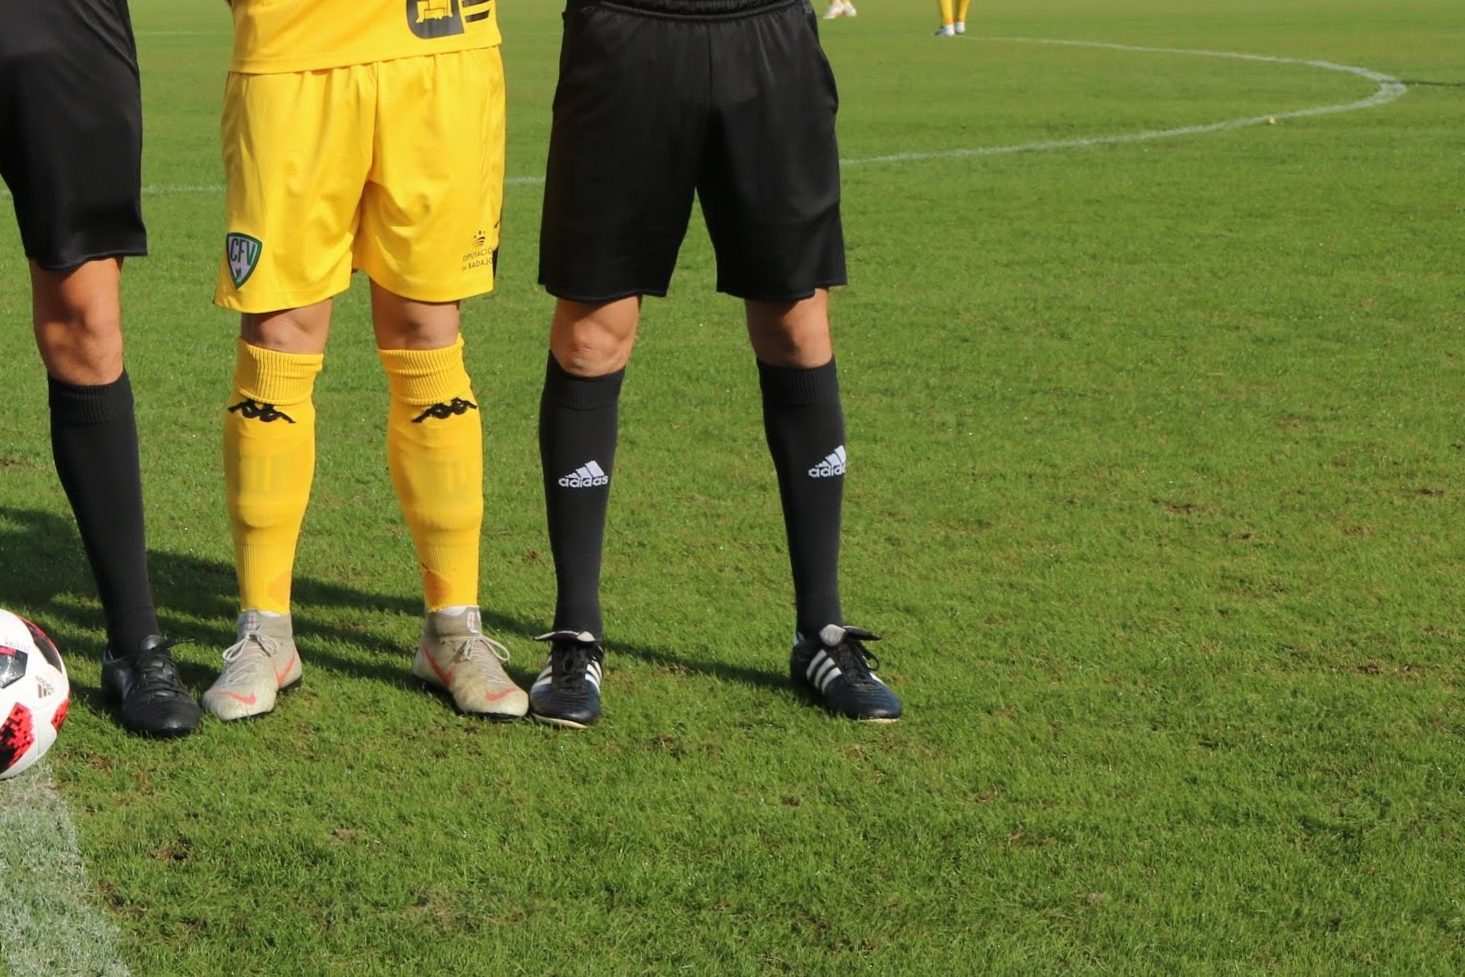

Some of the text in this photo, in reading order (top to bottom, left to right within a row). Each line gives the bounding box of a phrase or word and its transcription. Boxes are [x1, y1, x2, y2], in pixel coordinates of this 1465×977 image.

[230, 237, 256, 266] CFV
[468, 257, 492, 269] BADAJO
[808, 464, 846, 478] adid
[558, 474, 609, 488] adidas
